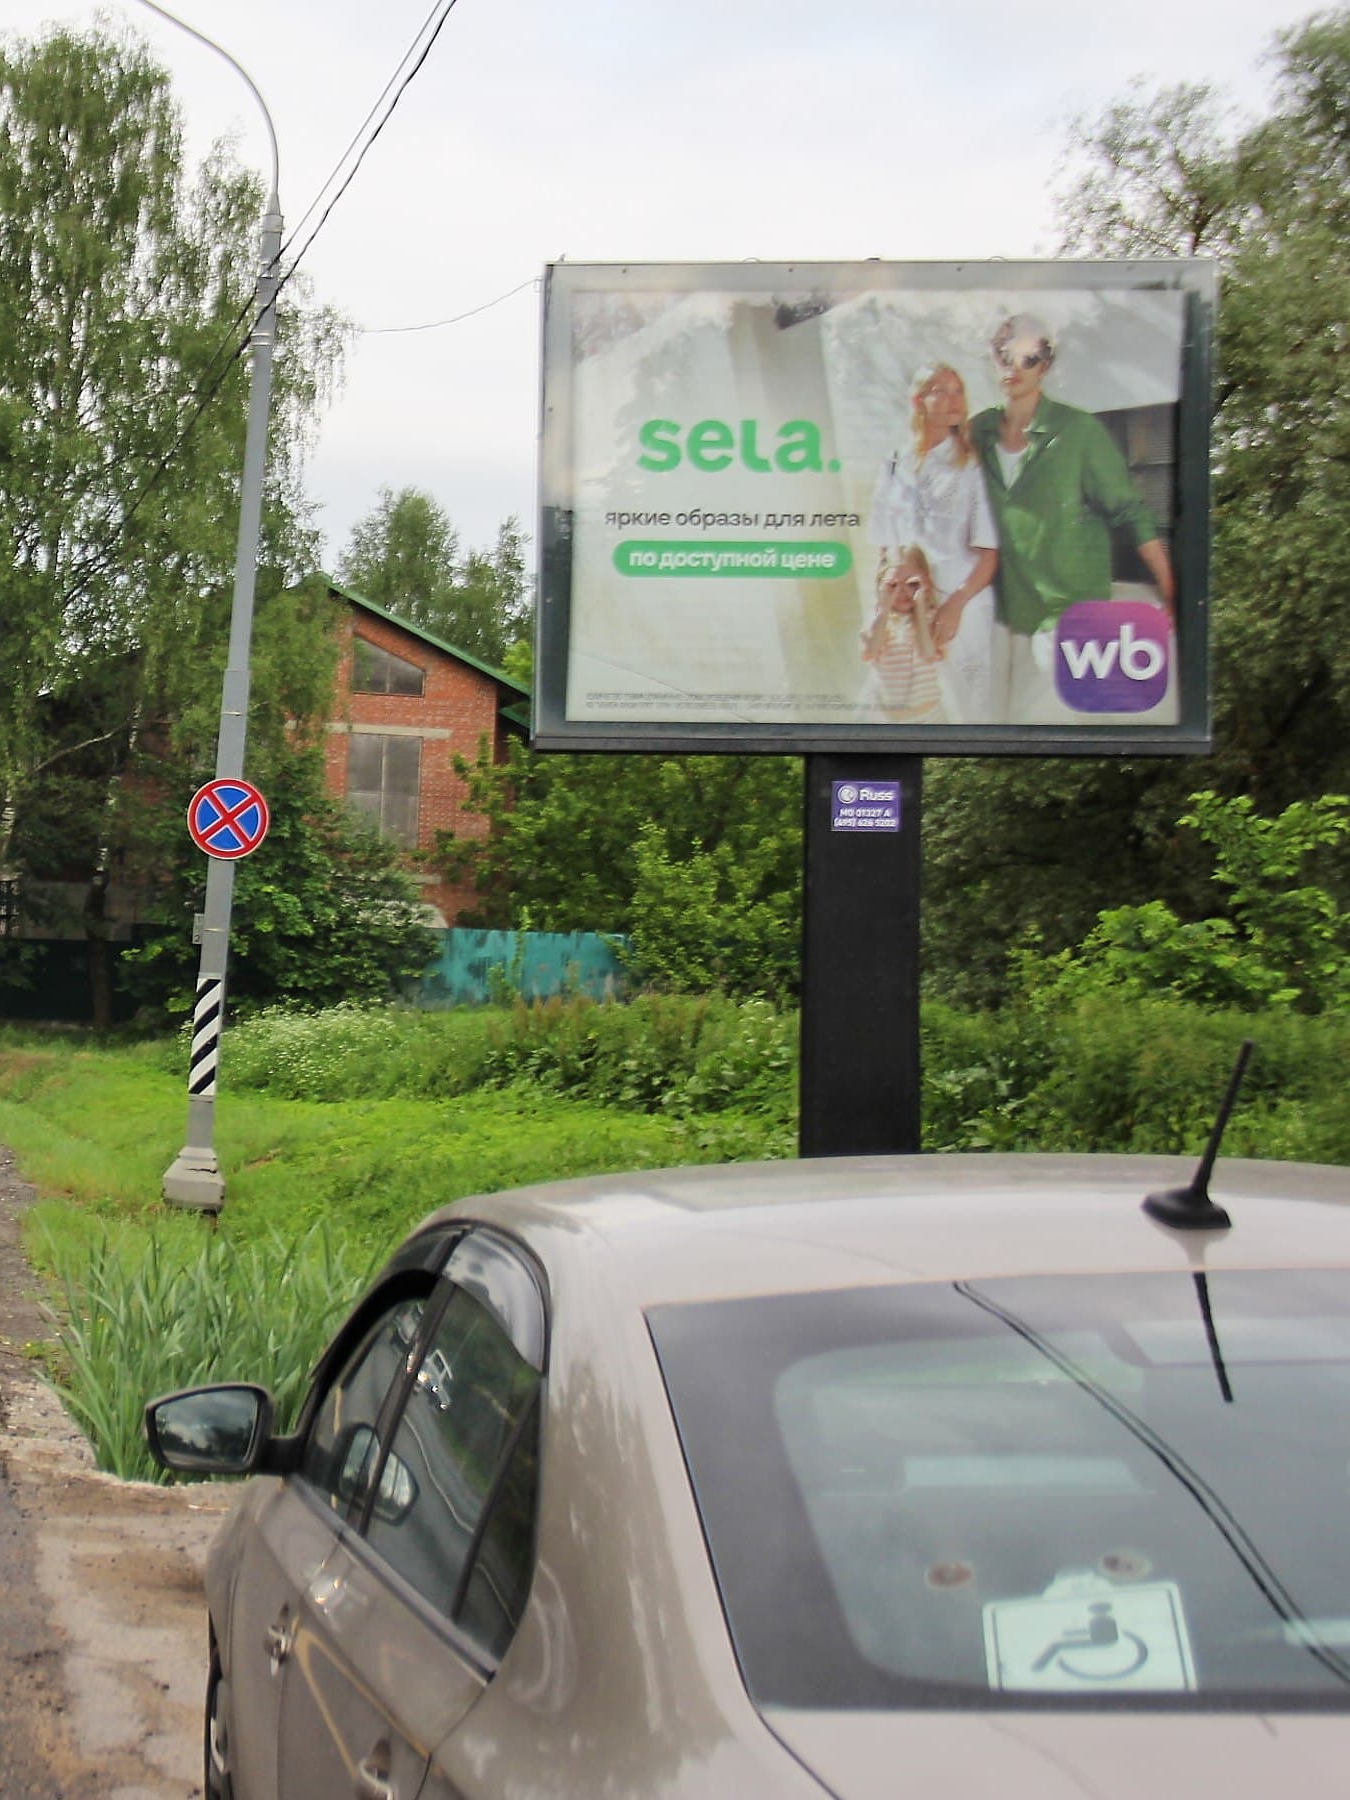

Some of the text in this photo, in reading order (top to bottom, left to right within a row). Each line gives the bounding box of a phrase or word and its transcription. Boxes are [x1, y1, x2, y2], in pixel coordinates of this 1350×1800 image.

[637, 419, 842, 474] sela.
[605, 507, 861, 531] яркие образы для лета
[629, 549, 836, 571] по доступной цене
[1060, 624, 1165, 681] wb
[859, 788, 895, 801] Russ
